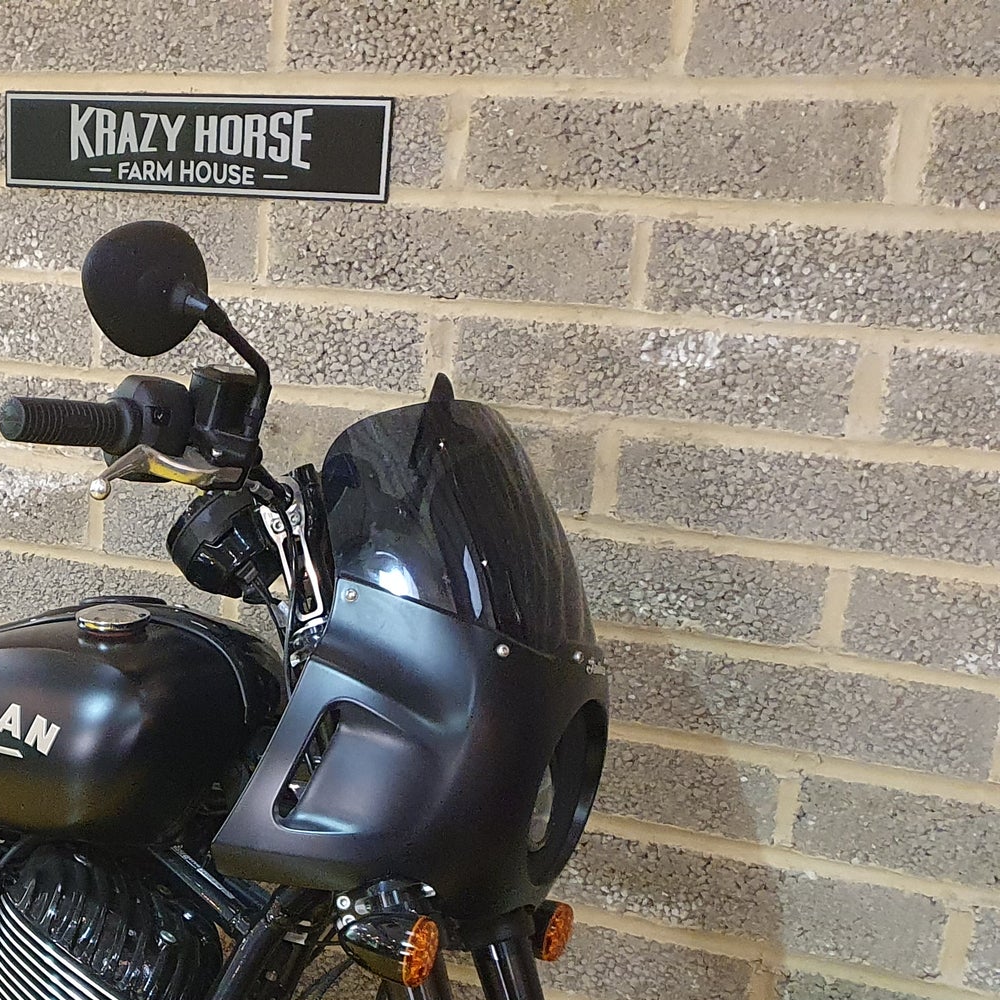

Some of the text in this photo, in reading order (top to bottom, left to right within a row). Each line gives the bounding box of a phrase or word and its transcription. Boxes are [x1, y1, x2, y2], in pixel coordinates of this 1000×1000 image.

[70, 103, 314, 170] KRAZY HORSE
[117, 160, 256, 186] FARM HOUSE
